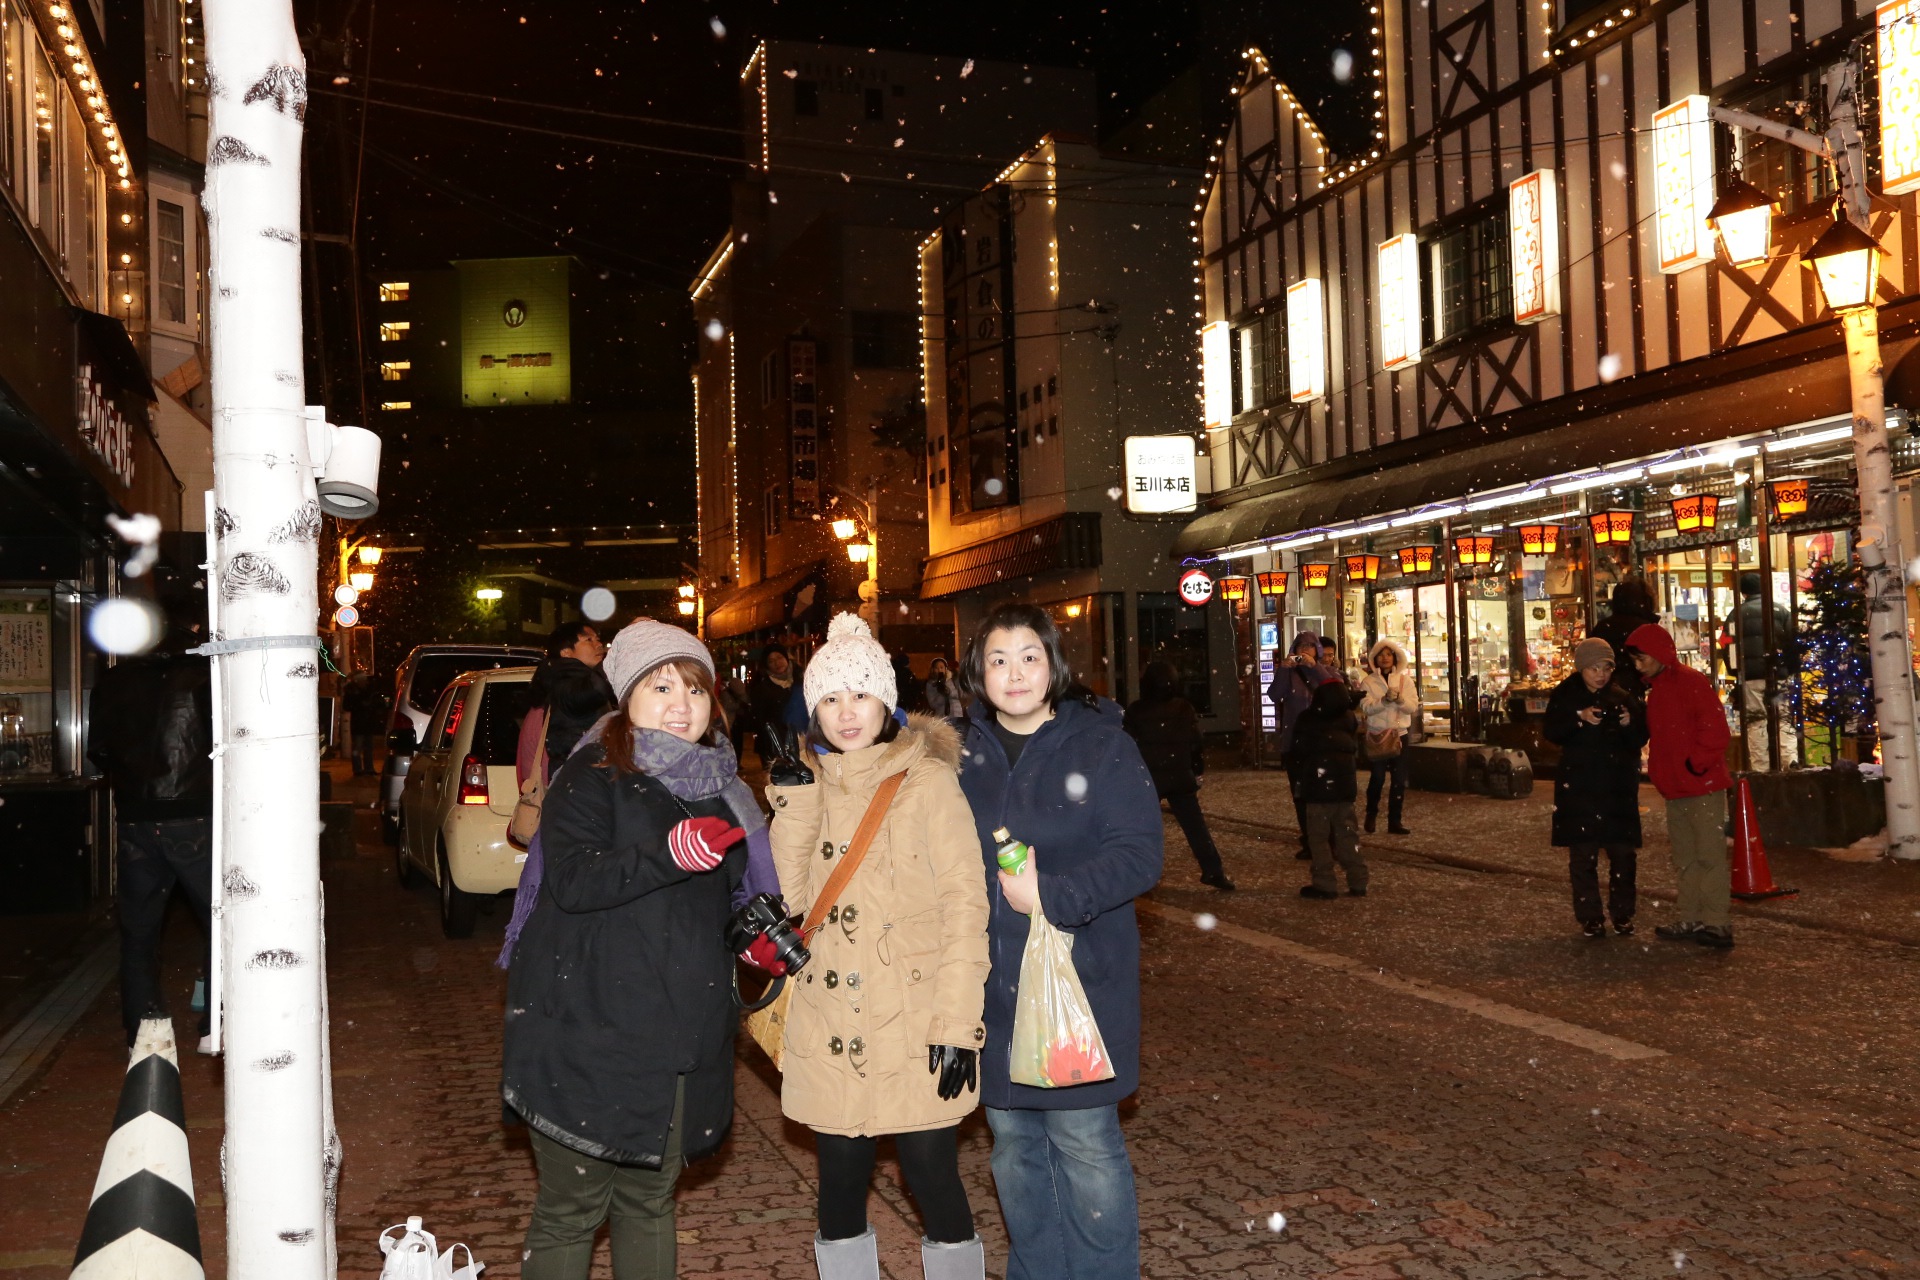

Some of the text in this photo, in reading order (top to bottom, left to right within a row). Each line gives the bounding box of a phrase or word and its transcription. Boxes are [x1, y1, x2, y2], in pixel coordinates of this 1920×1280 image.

[1134, 476, 1190, 492] 玉川本店
[1182, 581, 1210, 594] たばこ
